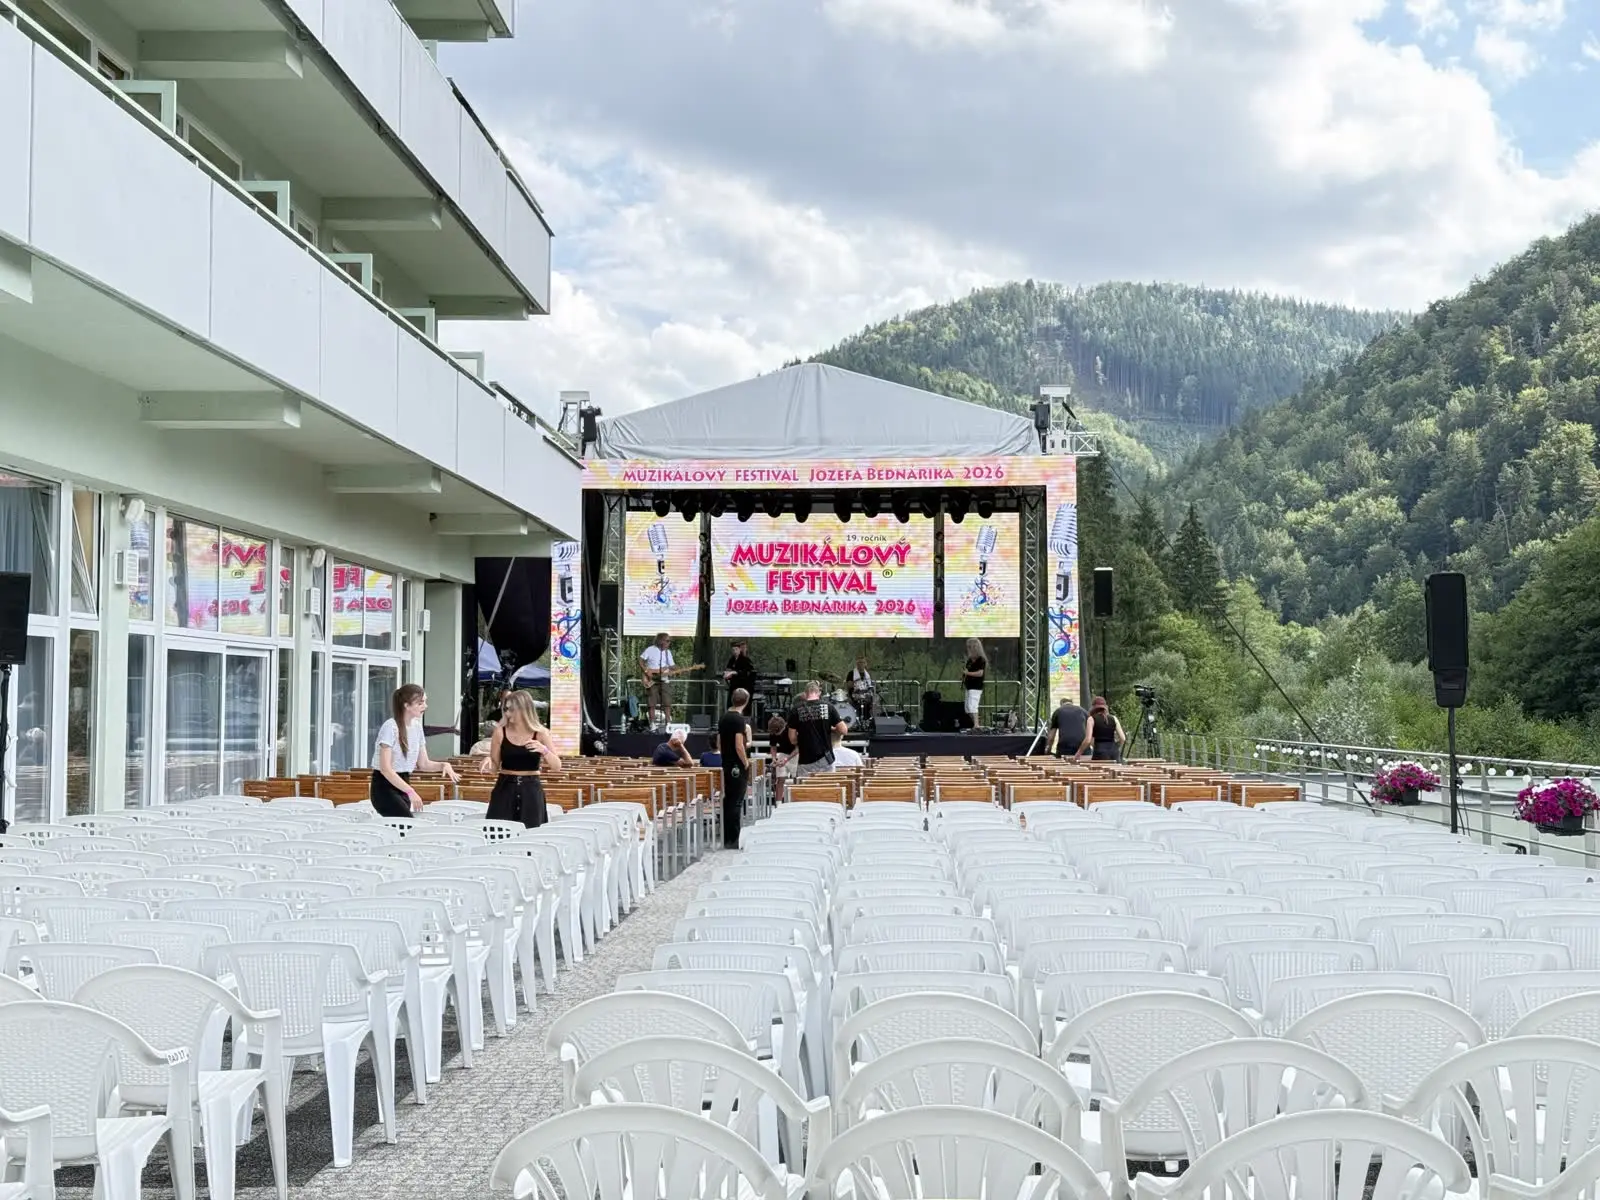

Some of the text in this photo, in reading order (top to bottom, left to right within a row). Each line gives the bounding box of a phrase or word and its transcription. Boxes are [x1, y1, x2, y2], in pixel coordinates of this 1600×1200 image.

[622, 464, 1004, 482] MUZIKÁLOVÝ FESTIVAL JOZEFA BEDNÁRIKA 2026
[846, 534, 859, 542] 19.
[731, 536, 912, 566] MUZIKÁLOVÝ
[767, 570, 878, 594] FESTIVAL
[726, 597, 916, 615] JOZEFA BEDNÁRIKA 2026
